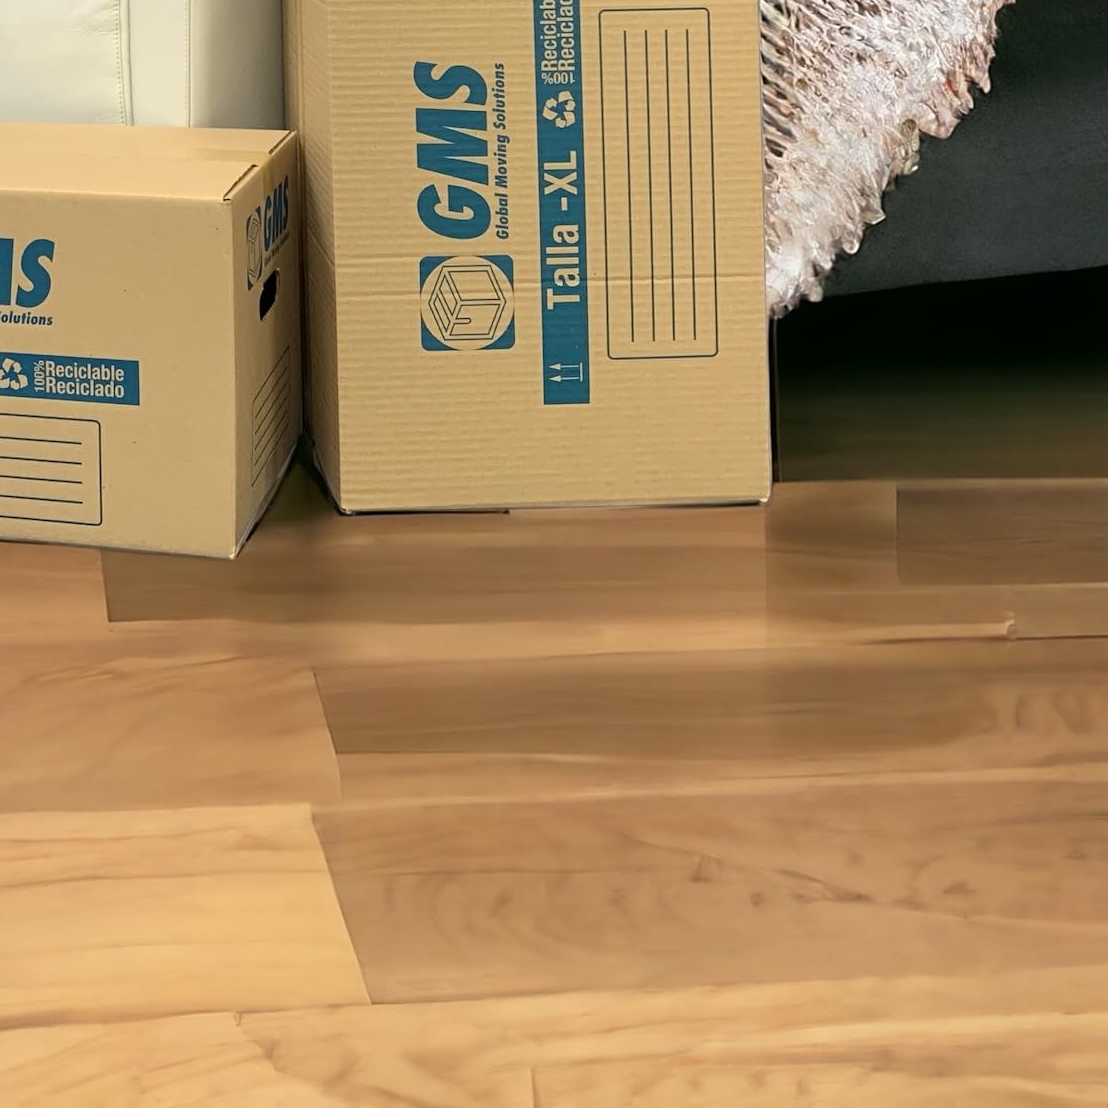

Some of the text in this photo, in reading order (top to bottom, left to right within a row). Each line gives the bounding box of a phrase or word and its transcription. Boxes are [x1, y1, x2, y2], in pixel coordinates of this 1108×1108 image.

[541, 72, 576, 85] 100%
[413, 60, 492, 240] GMS
[493, 62, 511, 240] Global Moving Solutions
[264, 174, 289, 252] GMS
[544, 150, 581, 310] Talla -XL
[33, 359, 45, 392] 100%
[45, 360, 125, 382] Reciclable
[45, 375, 125, 399] Reciclado
